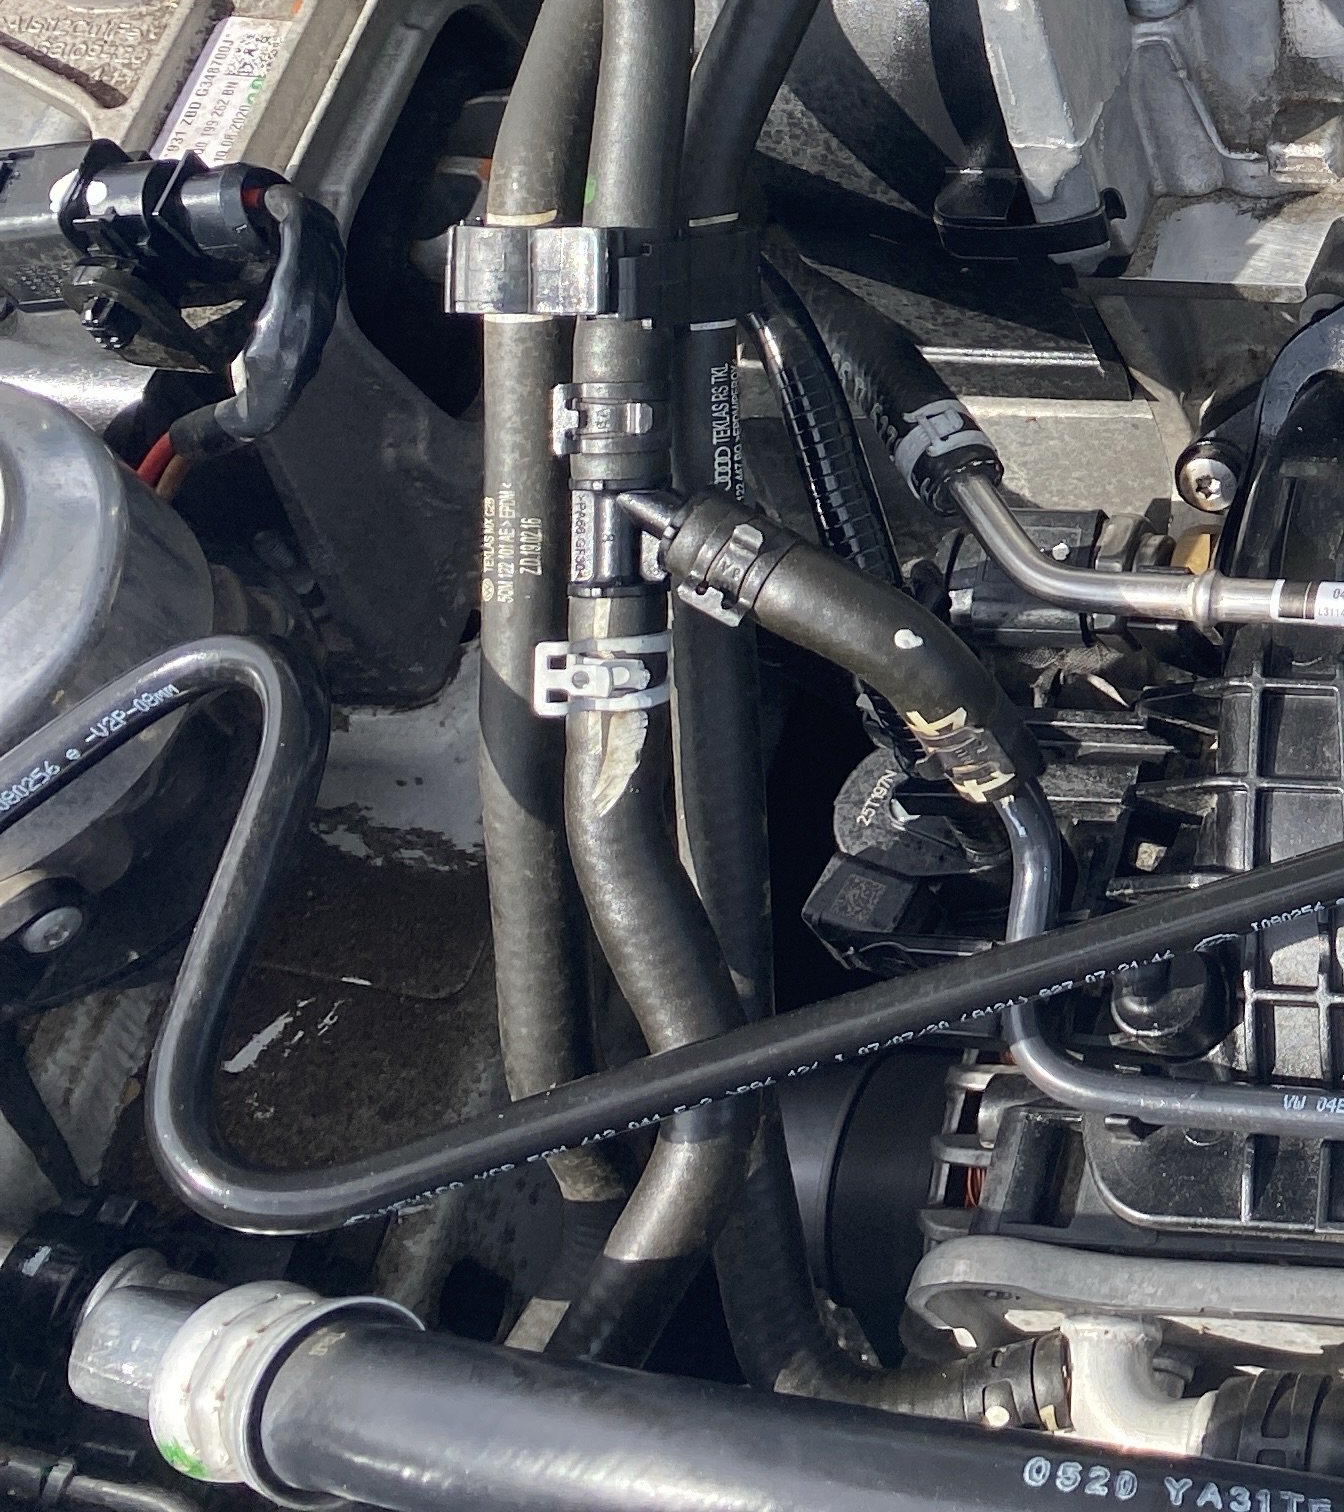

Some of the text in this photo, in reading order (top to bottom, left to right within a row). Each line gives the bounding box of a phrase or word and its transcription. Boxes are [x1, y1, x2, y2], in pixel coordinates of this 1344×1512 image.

[711, 361, 730, 444] TEKLAS RS TKL
[483, 518, 494, 533] MX
[498, 527, 514, 541] AE
[482, 535, 495, 572] TEKLAS
[498, 544, 514, 558] 101
[497, 562, 514, 578] 122
[855, 767, 900, 829] 25T197N
[1283, 1095, 1307, 1112] VW
